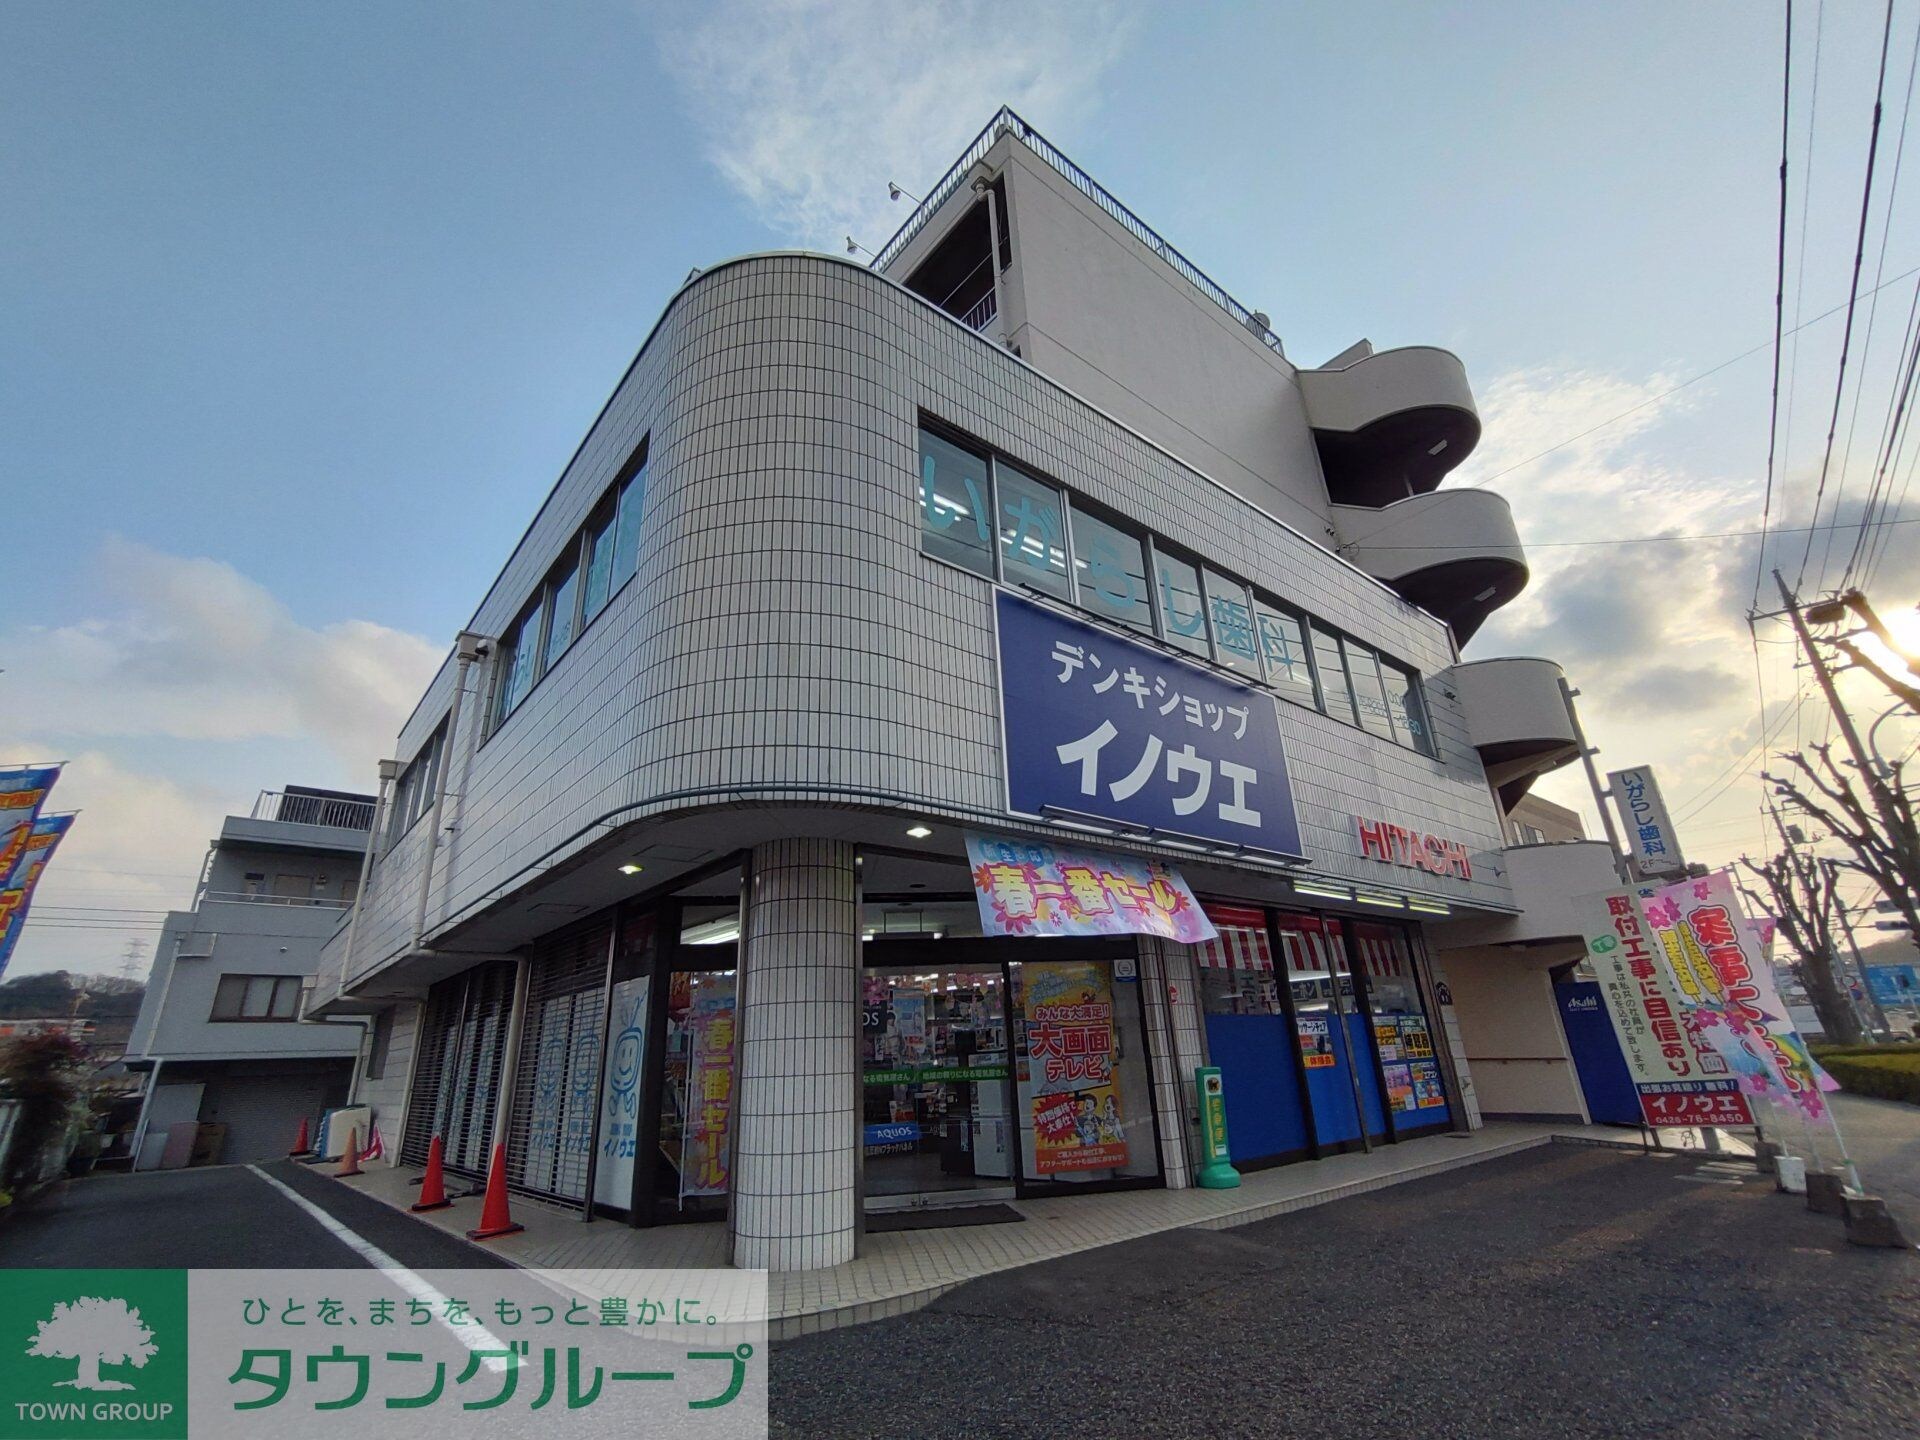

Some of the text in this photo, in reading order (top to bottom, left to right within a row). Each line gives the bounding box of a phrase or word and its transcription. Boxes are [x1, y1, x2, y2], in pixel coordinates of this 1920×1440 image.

[919, 456, 1295, 680] いがらし歯科
[1050, 641, 1250, 740] デンキショップ
[1056, 719, 1262, 829] イノウエ
[1357, 816, 1473, 880] HITACHI
[1621, 772, 1666, 856] いがらし歯科
[987, 863, 1180, 917] 春一番セール
[1605, 895, 1691, 1077] 取付工事に自信あり
[1028, 1022, 1112, 1059] 大画面
[1046, 1055, 1103, 1082] テレビ
[696, 1017, 734, 1188] 春一番セール
[877, 1126, 914, 1140] AQUOS
[1652, 1095, 1740, 1114] イノウエ
